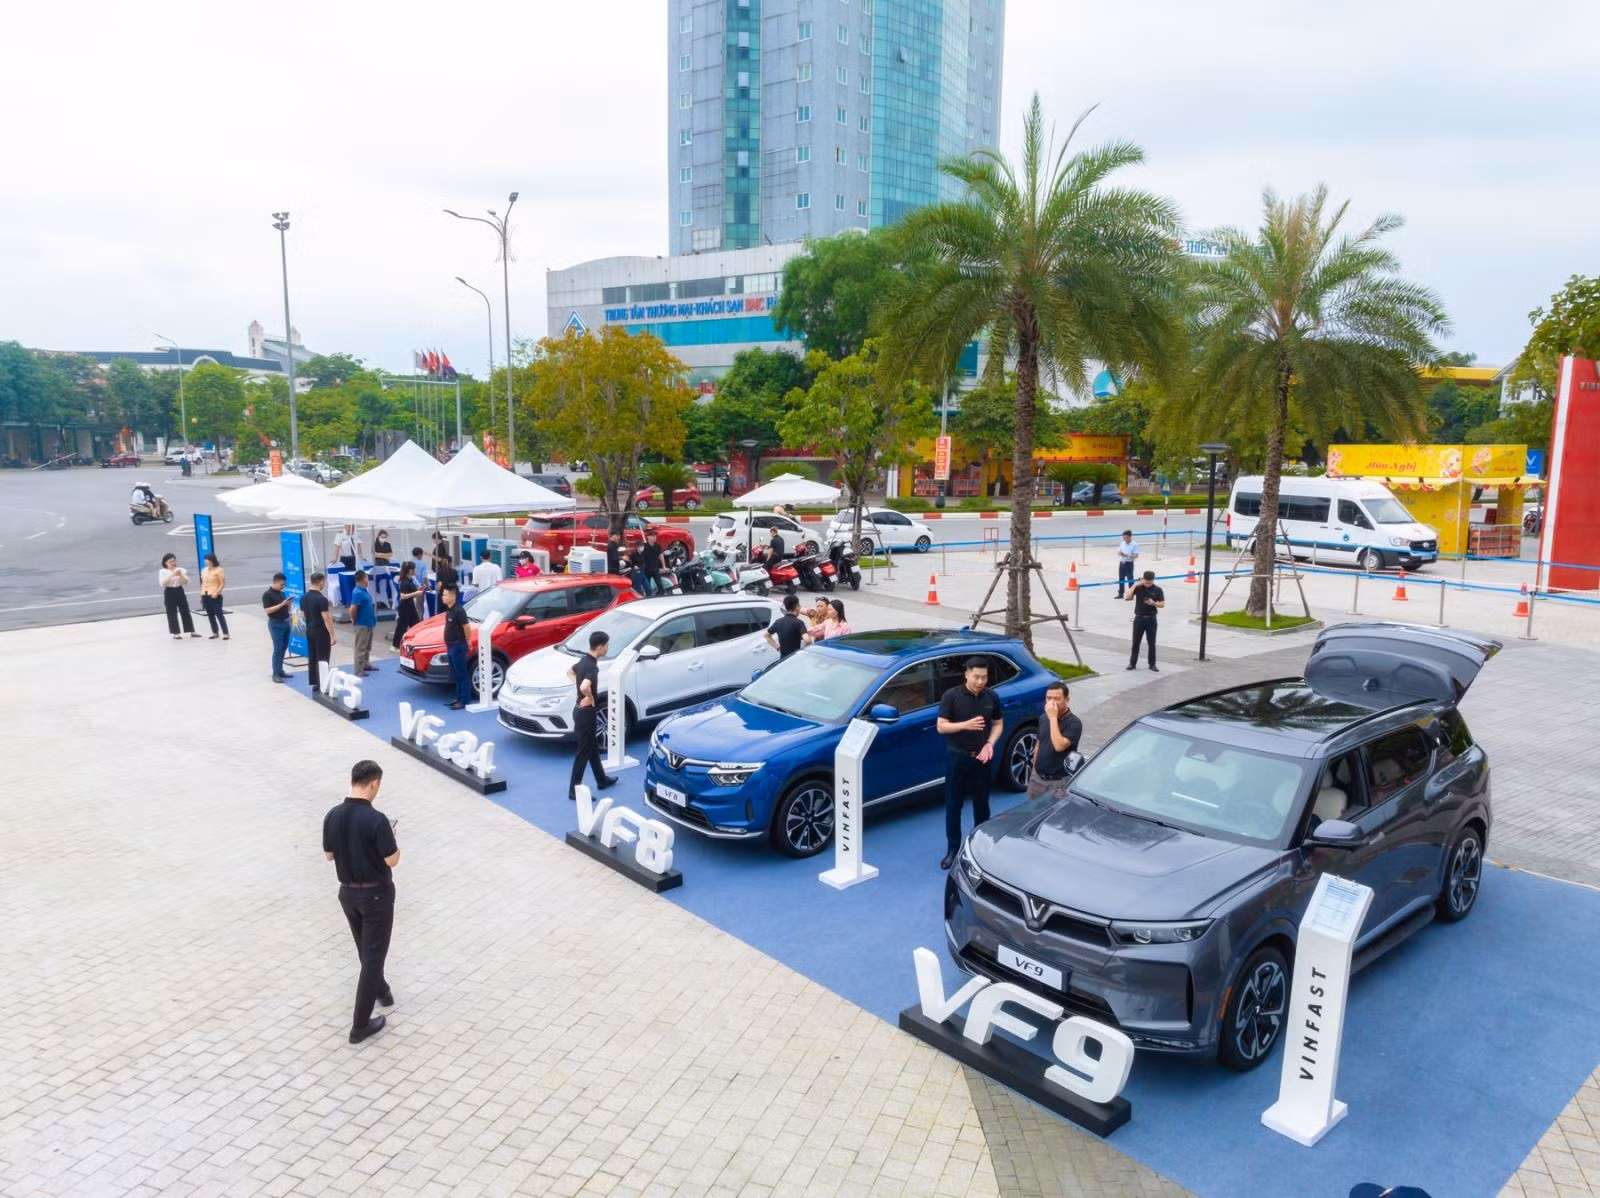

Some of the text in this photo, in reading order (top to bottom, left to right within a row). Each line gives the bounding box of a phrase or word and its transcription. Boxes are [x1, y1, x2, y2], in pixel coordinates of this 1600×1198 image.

[318, 660, 362, 709] VF5
[574, 784, 675, 875] VF8
[842, 777, 850, 852] VINFAST
[1014, 956, 1044, 977] VF9
[913, 946, 1135, 1104] VF9
[1299, 966, 1327, 1081] VINFAST
